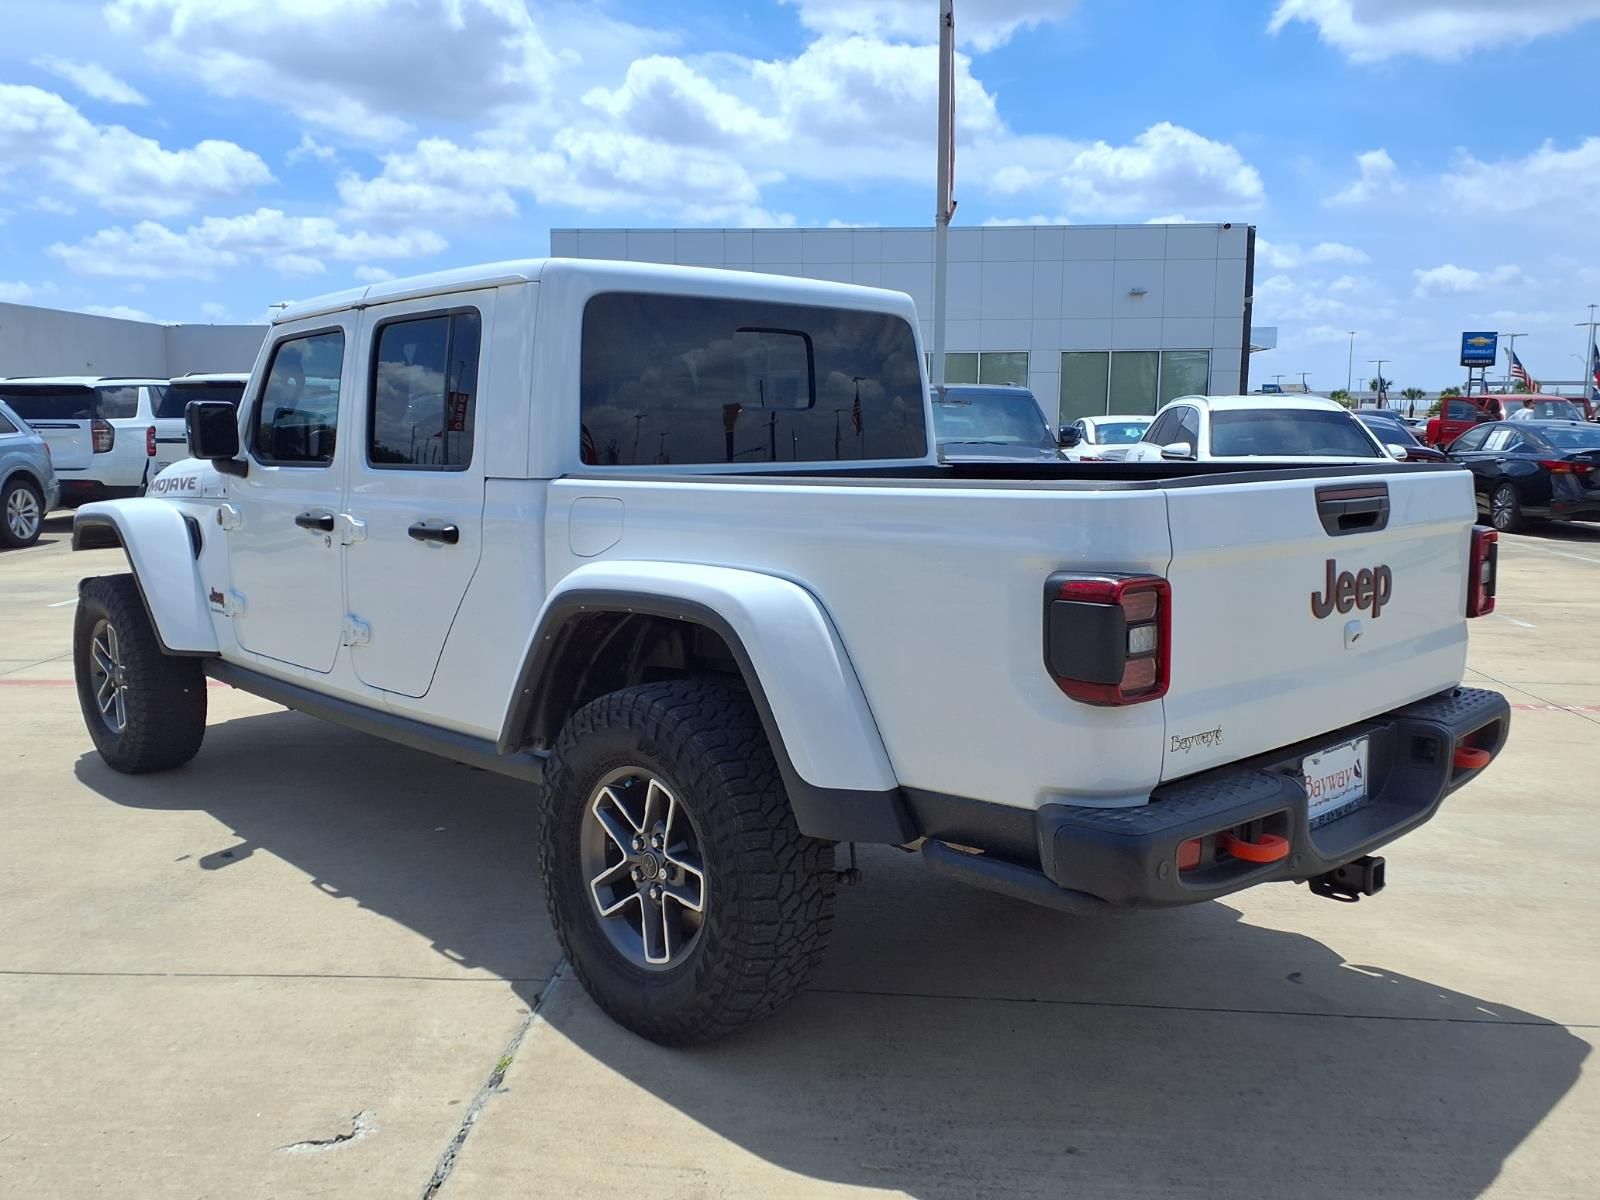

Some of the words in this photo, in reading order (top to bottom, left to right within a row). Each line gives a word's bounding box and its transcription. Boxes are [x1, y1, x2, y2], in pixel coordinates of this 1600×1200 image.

[149, 477, 197, 494] MOJAVE
[1311, 558, 1392, 619] Jeep
[1305, 767, 1352, 803] Bayway
